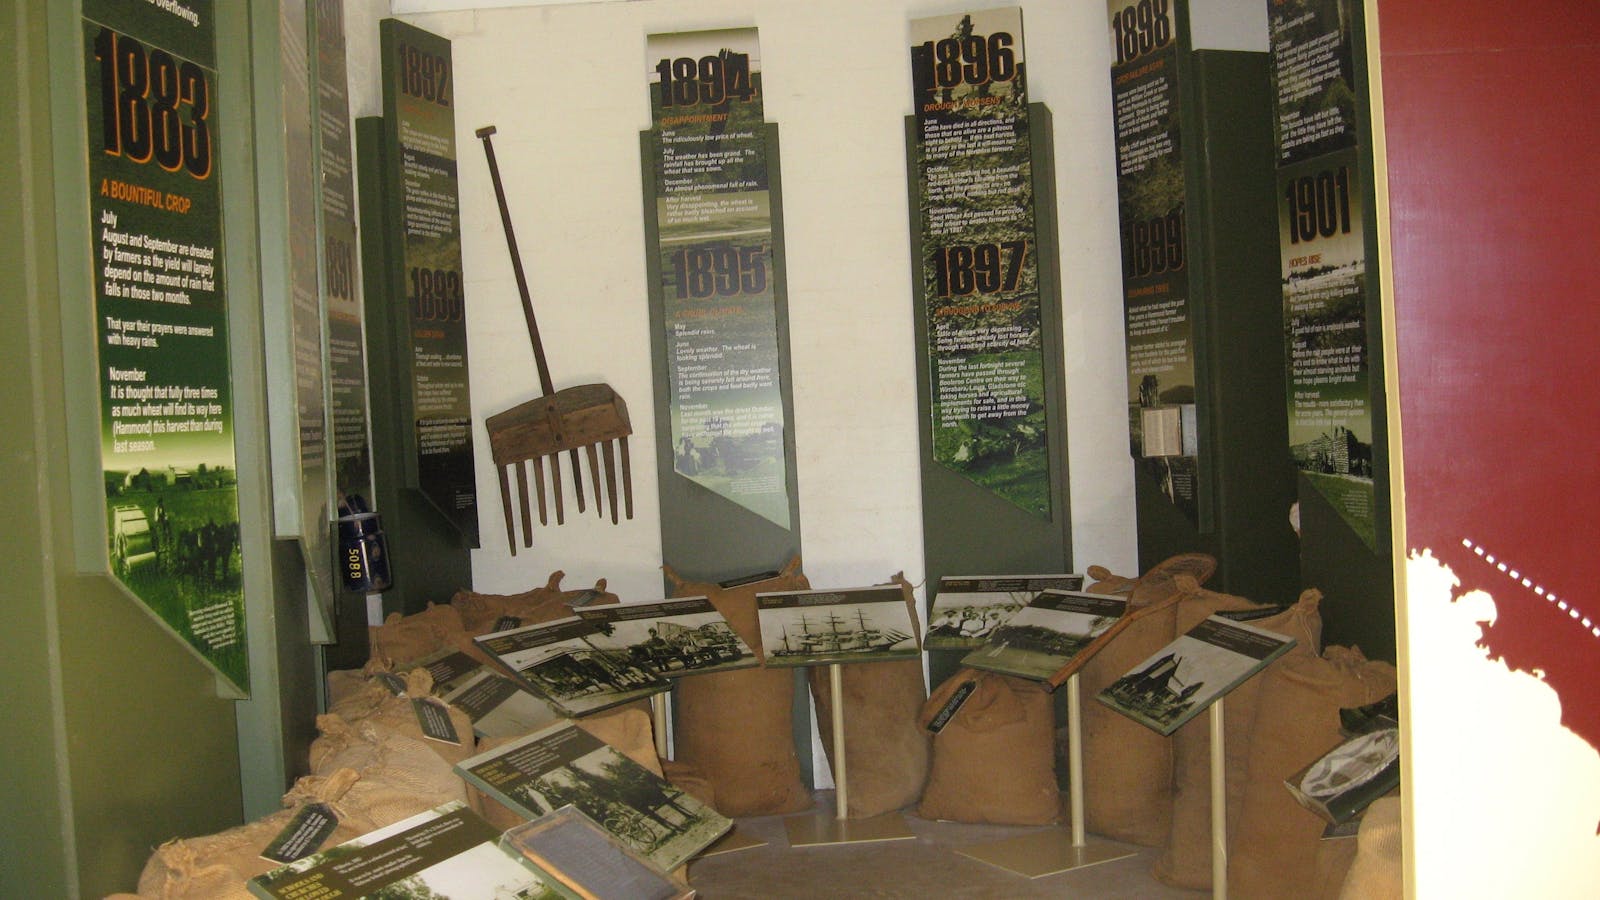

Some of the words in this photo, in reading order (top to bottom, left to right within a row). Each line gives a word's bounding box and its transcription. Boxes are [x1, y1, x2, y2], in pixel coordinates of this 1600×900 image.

[1113, 0, 1170, 65] 1898
[401, 43, 449, 106] 1892
[922, 32, 1016, 91] 1896
[656, 53, 757, 108] 1894
[95, 27, 211, 180] 1883
[662, 113, 728, 125] DISAPPOINTMENT
[673, 135, 704, 143] ridiculously
[695, 158, 717, 167] brought
[101, 179, 108, 194] A
[111, 181, 163, 208] BOUNTIFUL
[165, 193, 190, 214] CROP
[1286, 167, 1351, 244] 1901
[102, 209, 117, 229] July
[103, 227, 128, 246] August
[129, 234, 142, 247] and
[144, 235, 178, 253] September
[179, 244, 189, 255] are
[190, 244, 214, 259] dreaded
[1128, 214, 1185, 279] 1899
[104, 246, 113, 263] by
[114, 247, 141, 264] farmers
[143, 256, 151, 266] as
[153, 254, 163, 267] the
[165, 257, 180, 272] yield
[181, 259, 192, 272] will
[193, 261, 214, 279] largely
[671, 243, 767, 300] 1895
[936, 240, 1027, 297] 1897
[1289, 255, 1307, 268] HOPES
[104, 264, 131, 281] depend
[133, 271, 142, 281] on
[144, 270, 154, 283] the
[156, 274, 180, 287] amount
[181, 275, 188, 288] of
[189, 277, 201, 289] rain
[203, 279, 214, 291] that
[105, 281, 120, 296] falls
[123, 284, 129, 297] in
[131, 285, 150, 300] those
[152, 289, 164, 301] two
[165, 291, 191, 304] months.
[410, 267, 463, 323] 1893
[106, 317, 121, 330] That
[122, 321, 136, 333] year
[137, 320, 150, 332] their
[152, 323, 173, 335] prayers
[174, 326, 187, 335] were
[188, 326, 213, 336] answered
[107, 333, 121, 344] with
[122, 335, 140, 349] heavy
[142, 336, 159, 347] rains.
[109, 367, 146, 381] November
[111, 385, 117, 398] It
[118, 386, 124, 398] is
[126, 385, 153, 402] thought
[155, 386, 168, 399] that
[169, 386, 182, 402] fully
[184, 386, 200, 398] three
[201, 386, 218, 399] times
[112, 406, 120, 416] as
[122, 404, 141, 416] much
[143, 404, 162, 416] wheat
[163, 403, 174, 415] will
[175, 402, 187, 415] find
[196, 405, 208, 417] way
[209, 402, 222, 415] here
[113, 420, 152, 437] (Hammond)
[154, 420, 165, 433] this
[166, 419, 189, 433] harvest
[190, 419, 203, 432] than
[204, 419, 223, 433] during
[114, 439, 127, 453] last
[129, 441, 155, 452] season.
[349, 548, 362, 579] 5088
